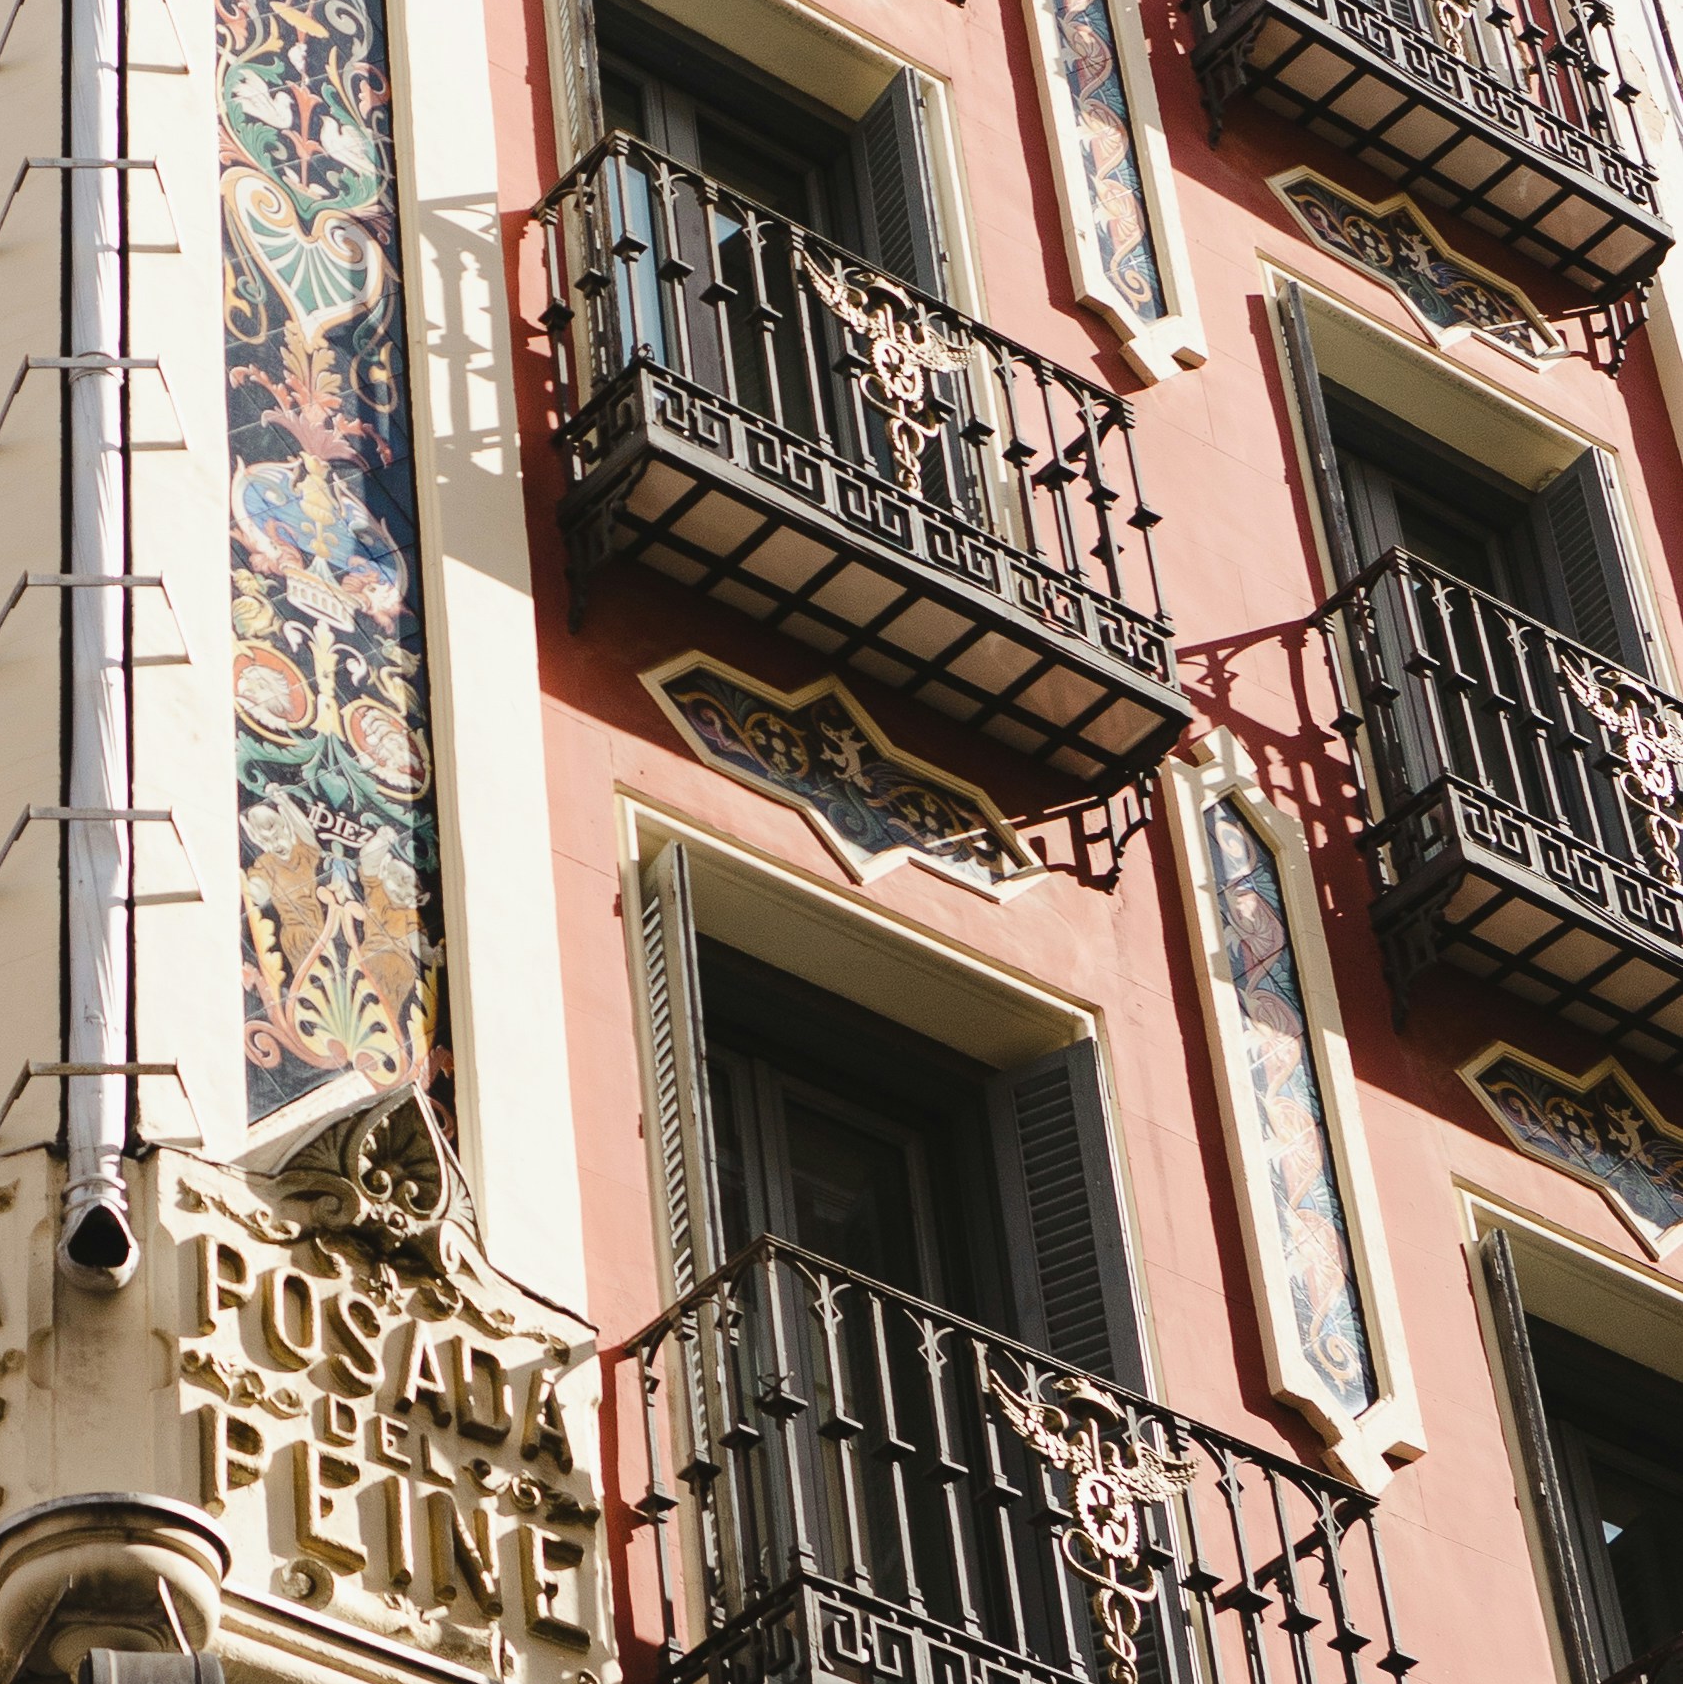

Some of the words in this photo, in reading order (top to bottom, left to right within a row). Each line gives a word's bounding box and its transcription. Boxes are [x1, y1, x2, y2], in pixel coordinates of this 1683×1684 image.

[195, 1233, 574, 1474] POSADA
[323, 1392, 455, 1489] DEL
[198, 1403, 593, 1653] PEINE
